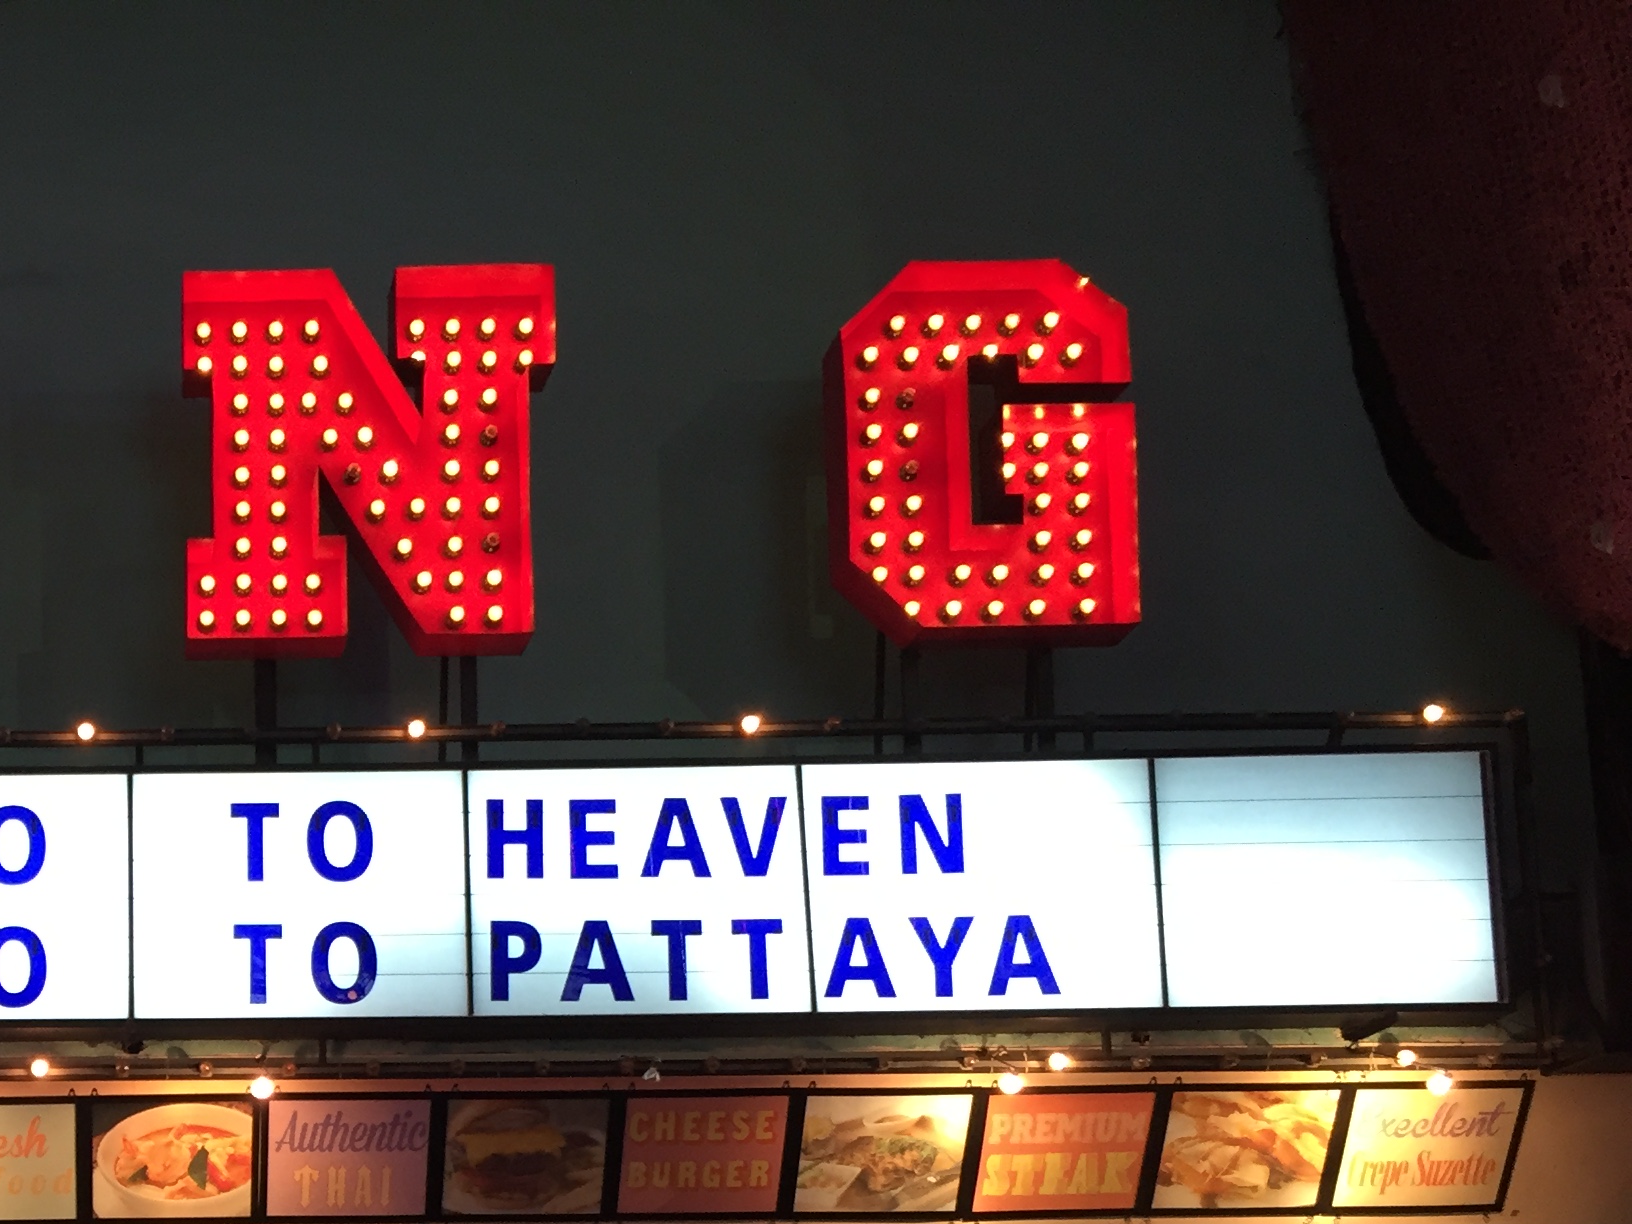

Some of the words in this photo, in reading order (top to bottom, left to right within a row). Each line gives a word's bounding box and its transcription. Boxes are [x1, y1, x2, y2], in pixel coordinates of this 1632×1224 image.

[231, 801, 373, 882] TO
[487, 794, 965, 879] HEAVEN
[234, 922, 378, 1003] TO
[492, 915, 1061, 1000] PATTAYA
[275, 1109, 428, 1152] Authentic
[629, 1110, 774, 1142] CHEESE
[988, 1111, 1149, 1144] PREMIUM
[294, 1164, 392, 1209] THAI
[627, 1160, 770, 1188] BURGER
[982, 1151, 1140, 1196] STEAK
[1411, 1149, 1497, 1187] Suzette
